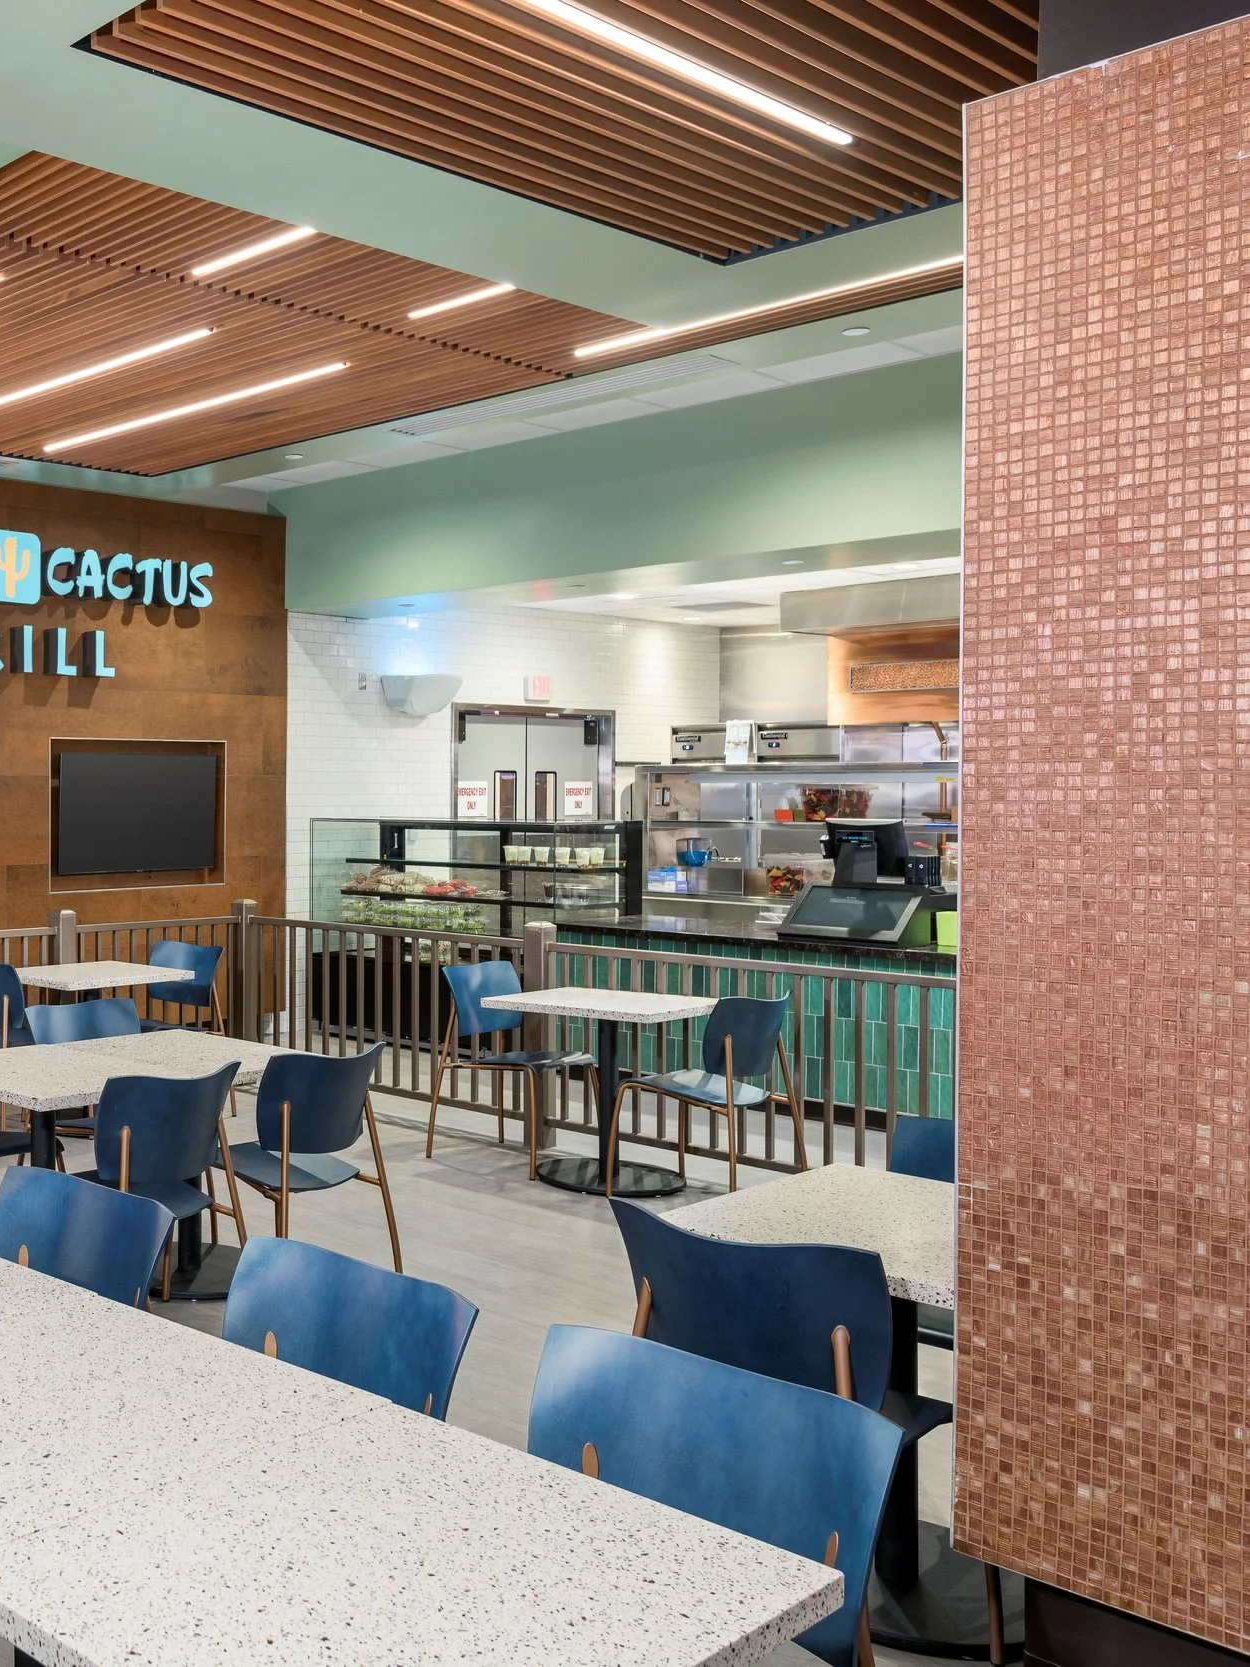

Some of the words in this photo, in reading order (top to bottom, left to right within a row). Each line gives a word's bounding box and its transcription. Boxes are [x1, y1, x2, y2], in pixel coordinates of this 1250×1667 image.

[46, 546, 214, 608] CACTUS
[533, 676, 550, 697] EXIT
[457, 787, 478, 796] EMERGENCY
[479, 787, 487, 796] EXIT
[565, 787, 584, 796] EMERGENCY
[584, 787, 592, 796] EXIT
[466, 801, 477, 810] ONLY
[574, 800, 583, 809] ONLY
